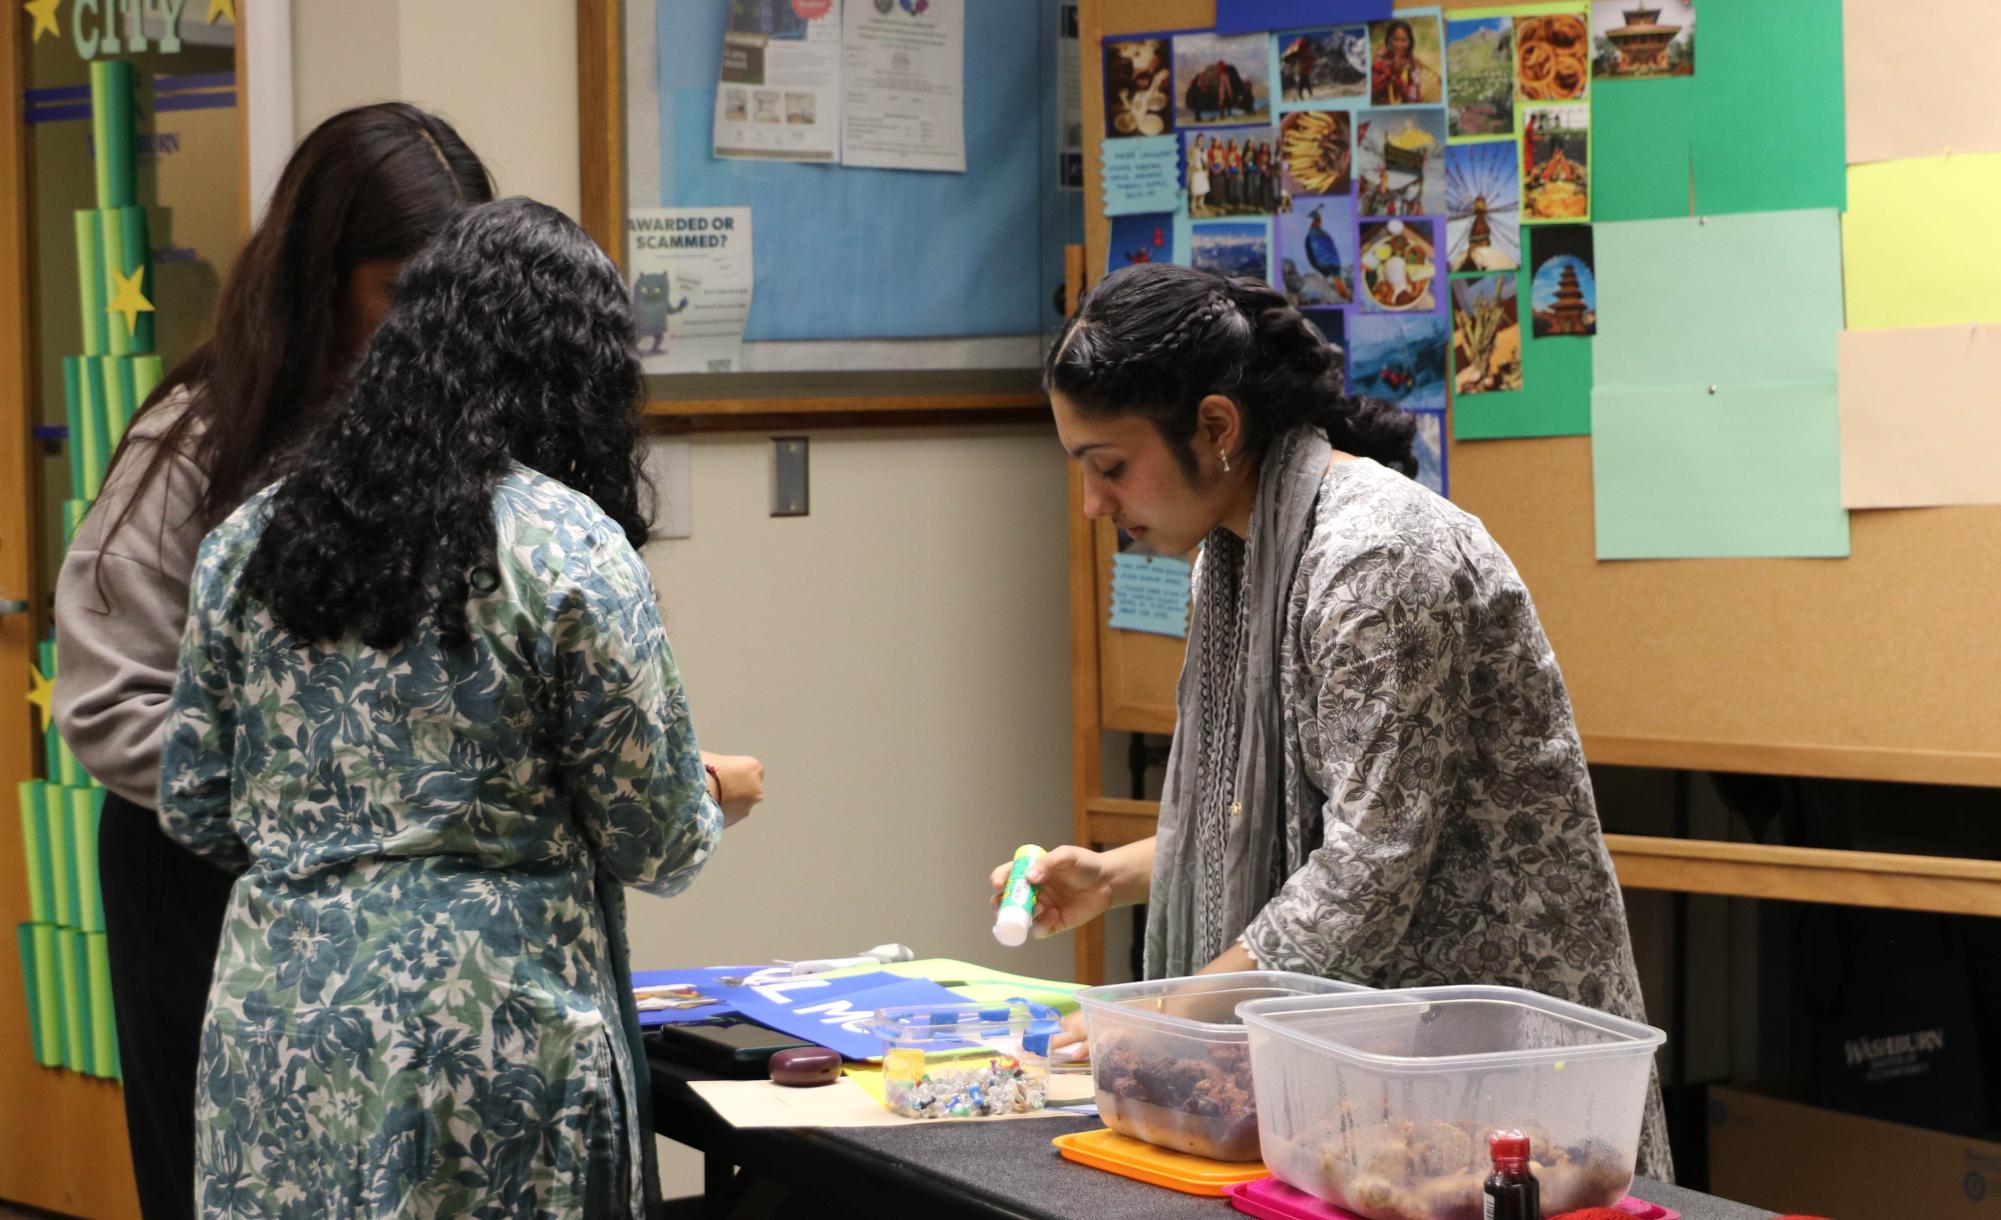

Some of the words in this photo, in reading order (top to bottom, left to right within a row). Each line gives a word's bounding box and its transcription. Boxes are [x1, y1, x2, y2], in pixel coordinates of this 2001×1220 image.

[72, 0, 182, 60] CITY
[712, 216, 734, 231] OR
[636, 234, 728, 250] SCAMMED?
